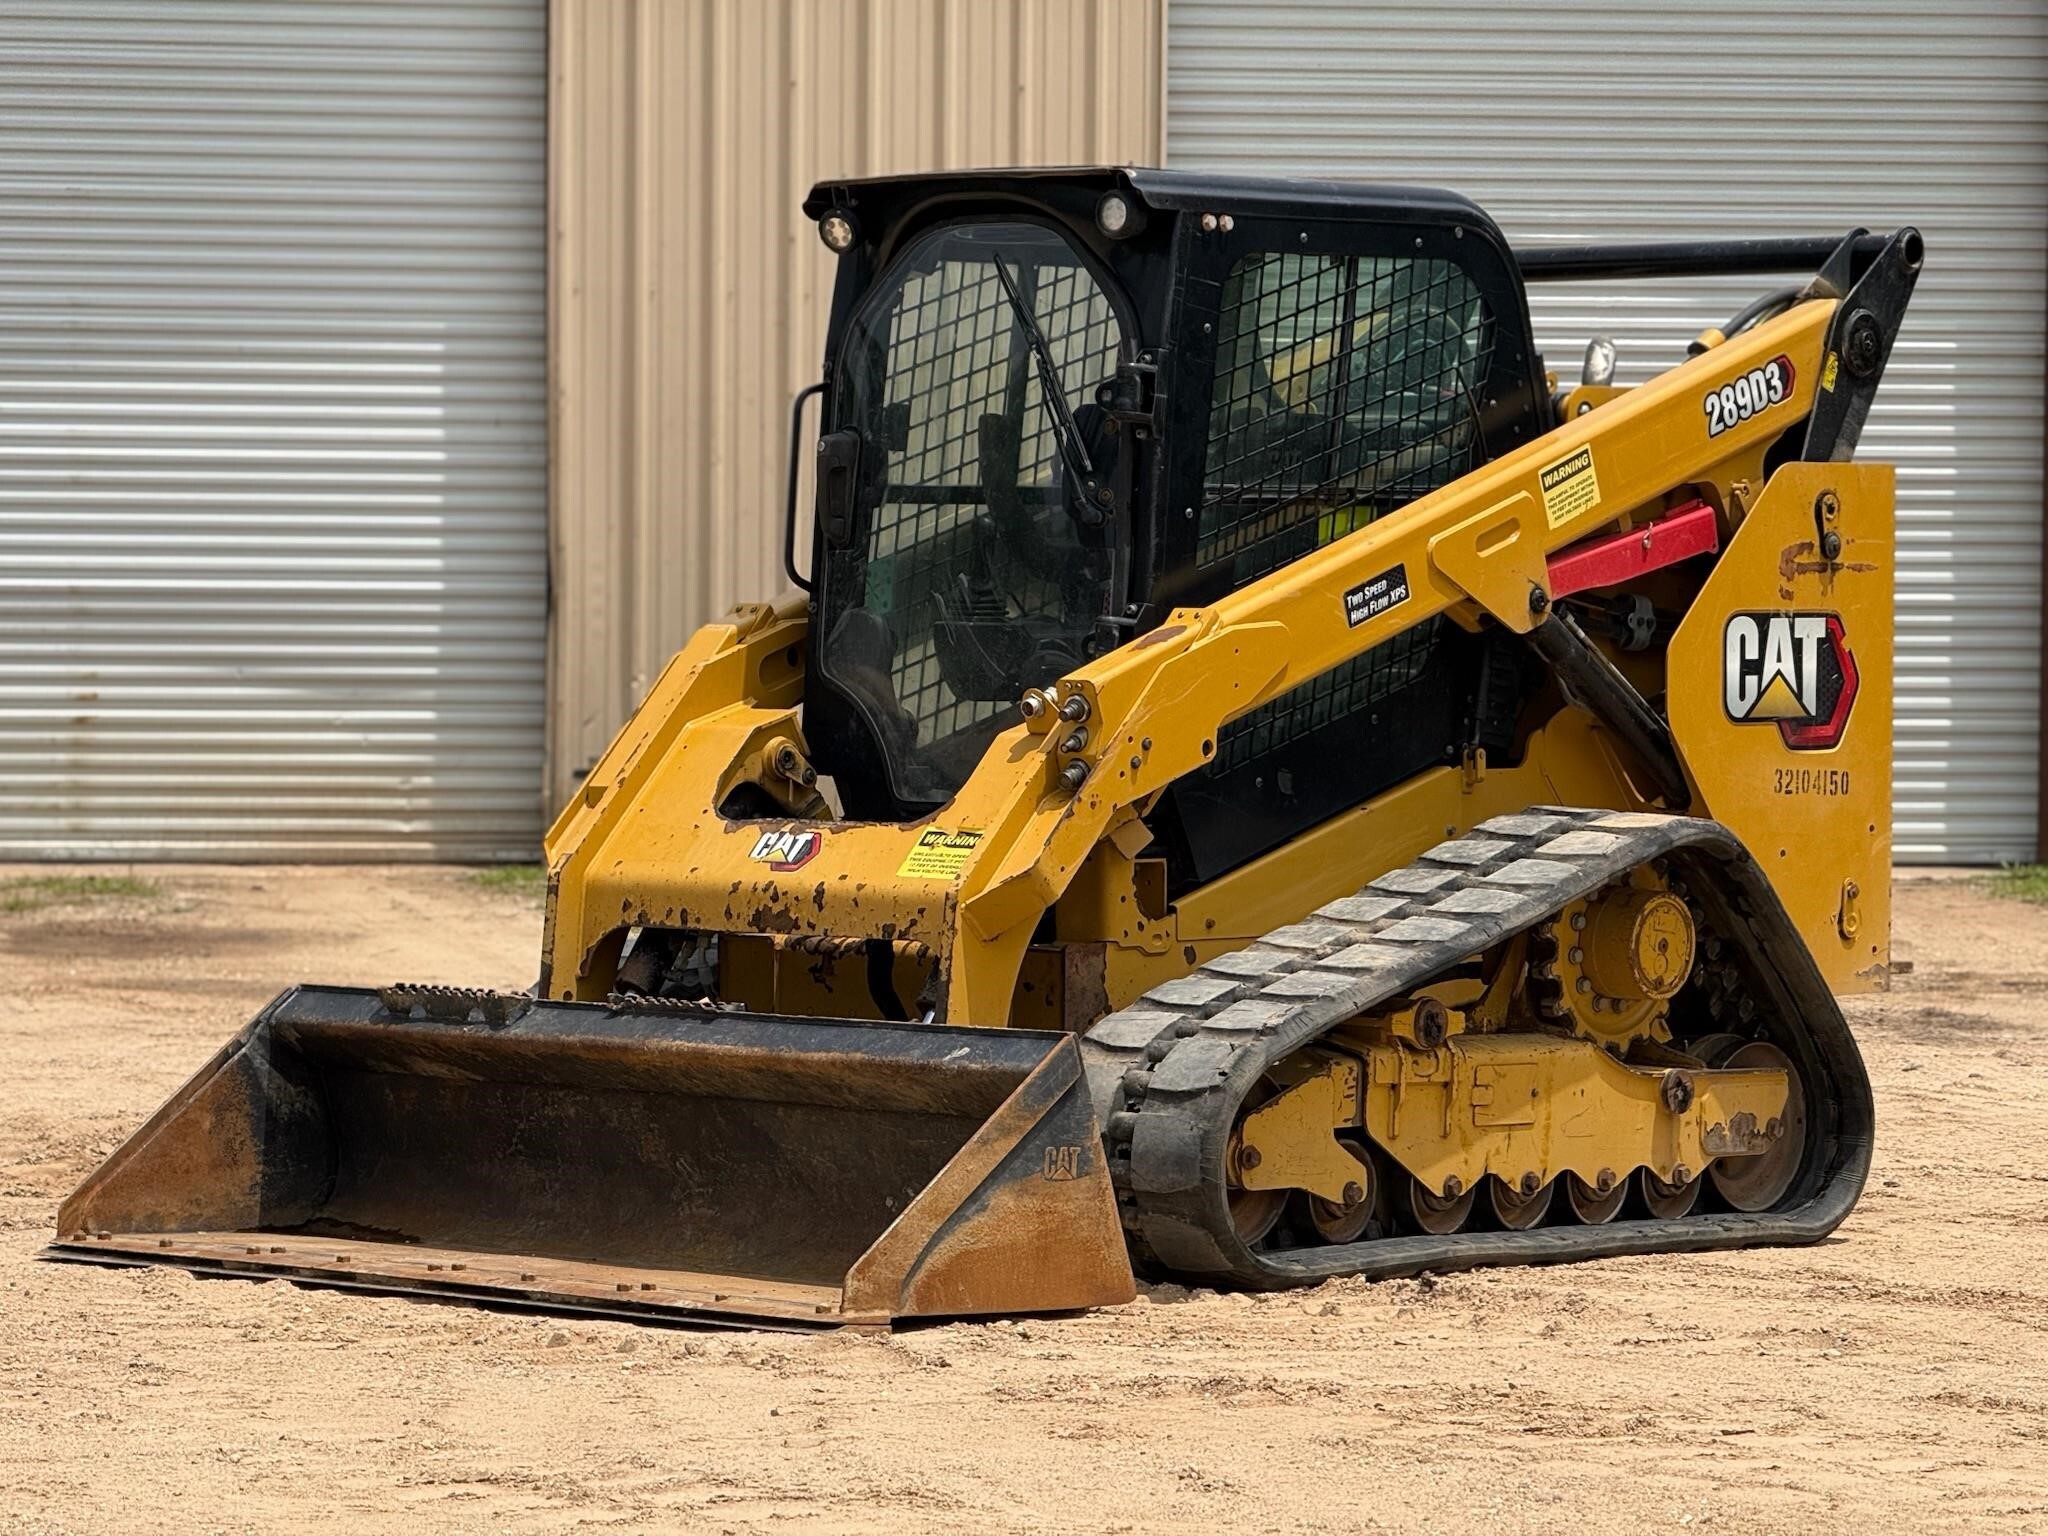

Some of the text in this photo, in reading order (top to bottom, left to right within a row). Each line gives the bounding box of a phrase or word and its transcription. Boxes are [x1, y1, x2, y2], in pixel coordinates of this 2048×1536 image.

[1705, 362, 1784, 435] 289D3
[1543, 454, 1590, 487] WARNING
[1390, 584, 1406, 603] XPS
[1726, 616, 1826, 718] CAT
[1773, 768, 1850, 796] 32104150
[750, 832, 814, 863] CAT
[924, 833, 979, 846] WARNIN
[1044, 1146, 1081, 1180] CAT
